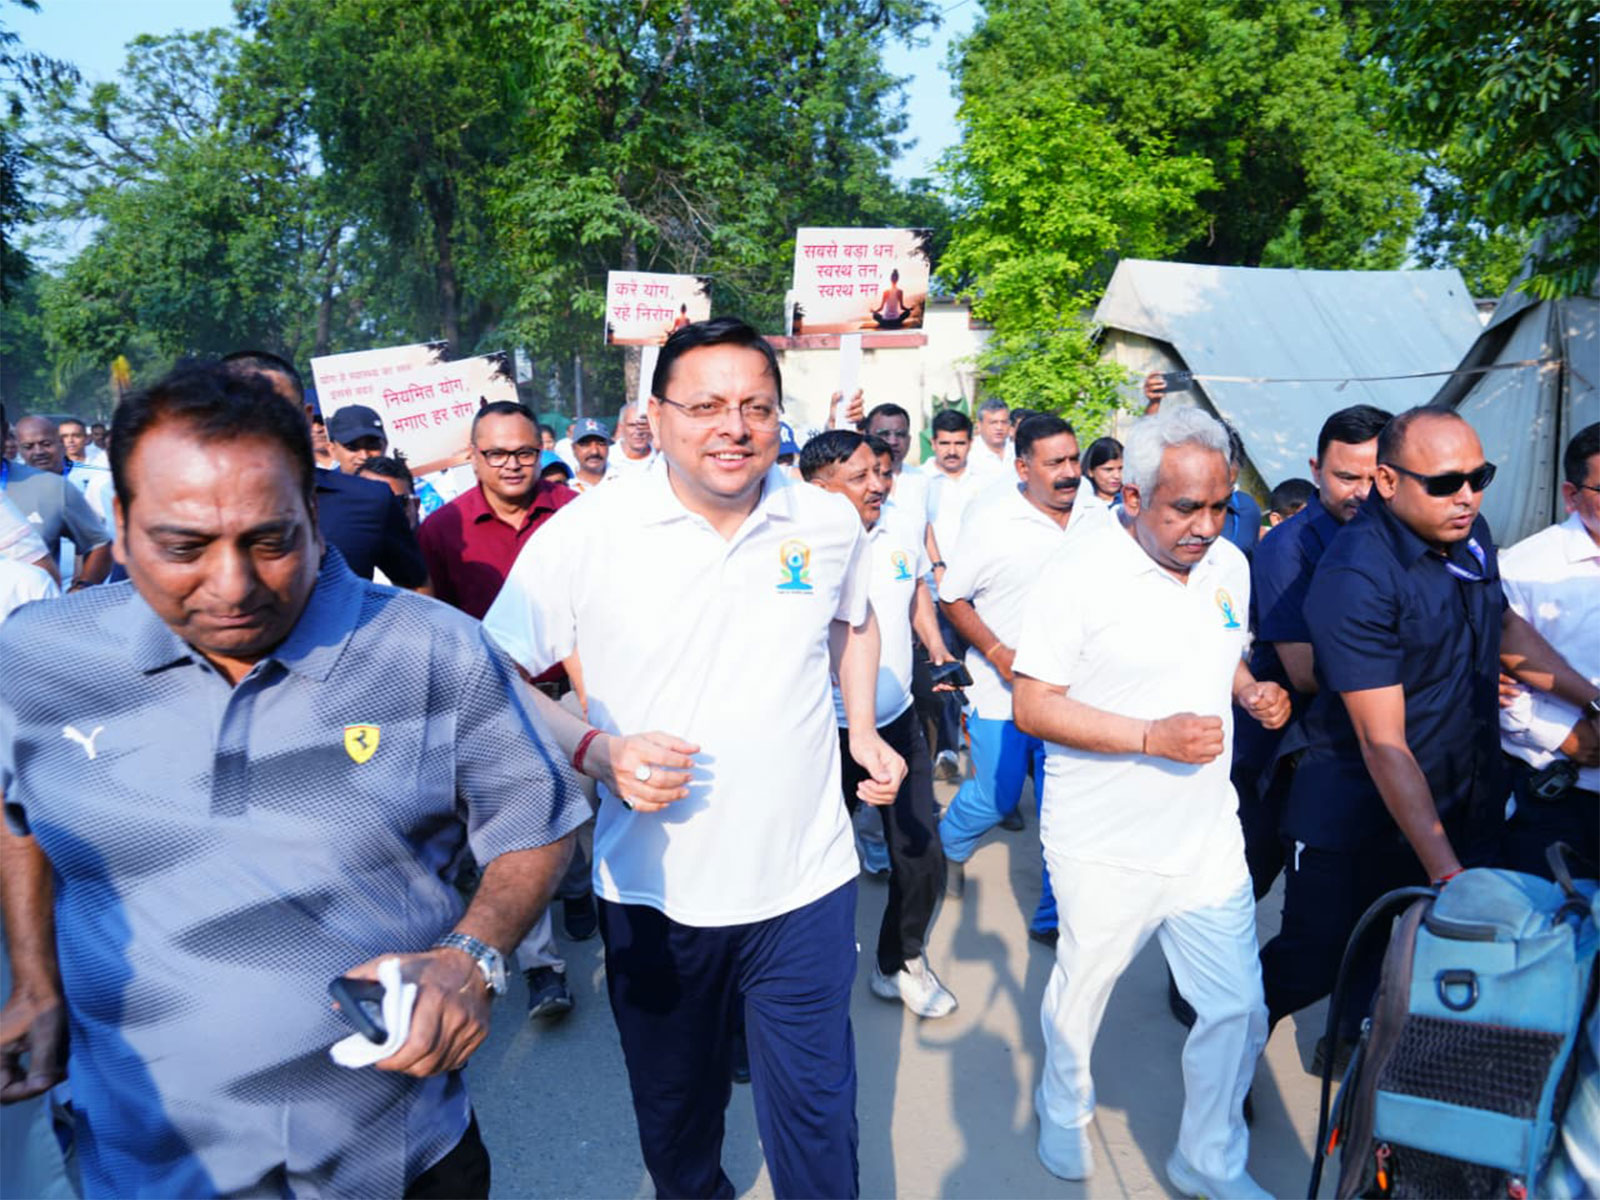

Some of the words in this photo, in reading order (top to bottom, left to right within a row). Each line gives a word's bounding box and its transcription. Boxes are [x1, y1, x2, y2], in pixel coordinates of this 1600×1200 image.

[802, 240, 838, 258] सबसे
[859, 284, 879, 297] मन
[636, 302, 675, 321] निरोग
[382, 383, 435, 408] नियमित
[431, 408, 449, 425] हर
[451, 400, 474, 419] रोग
